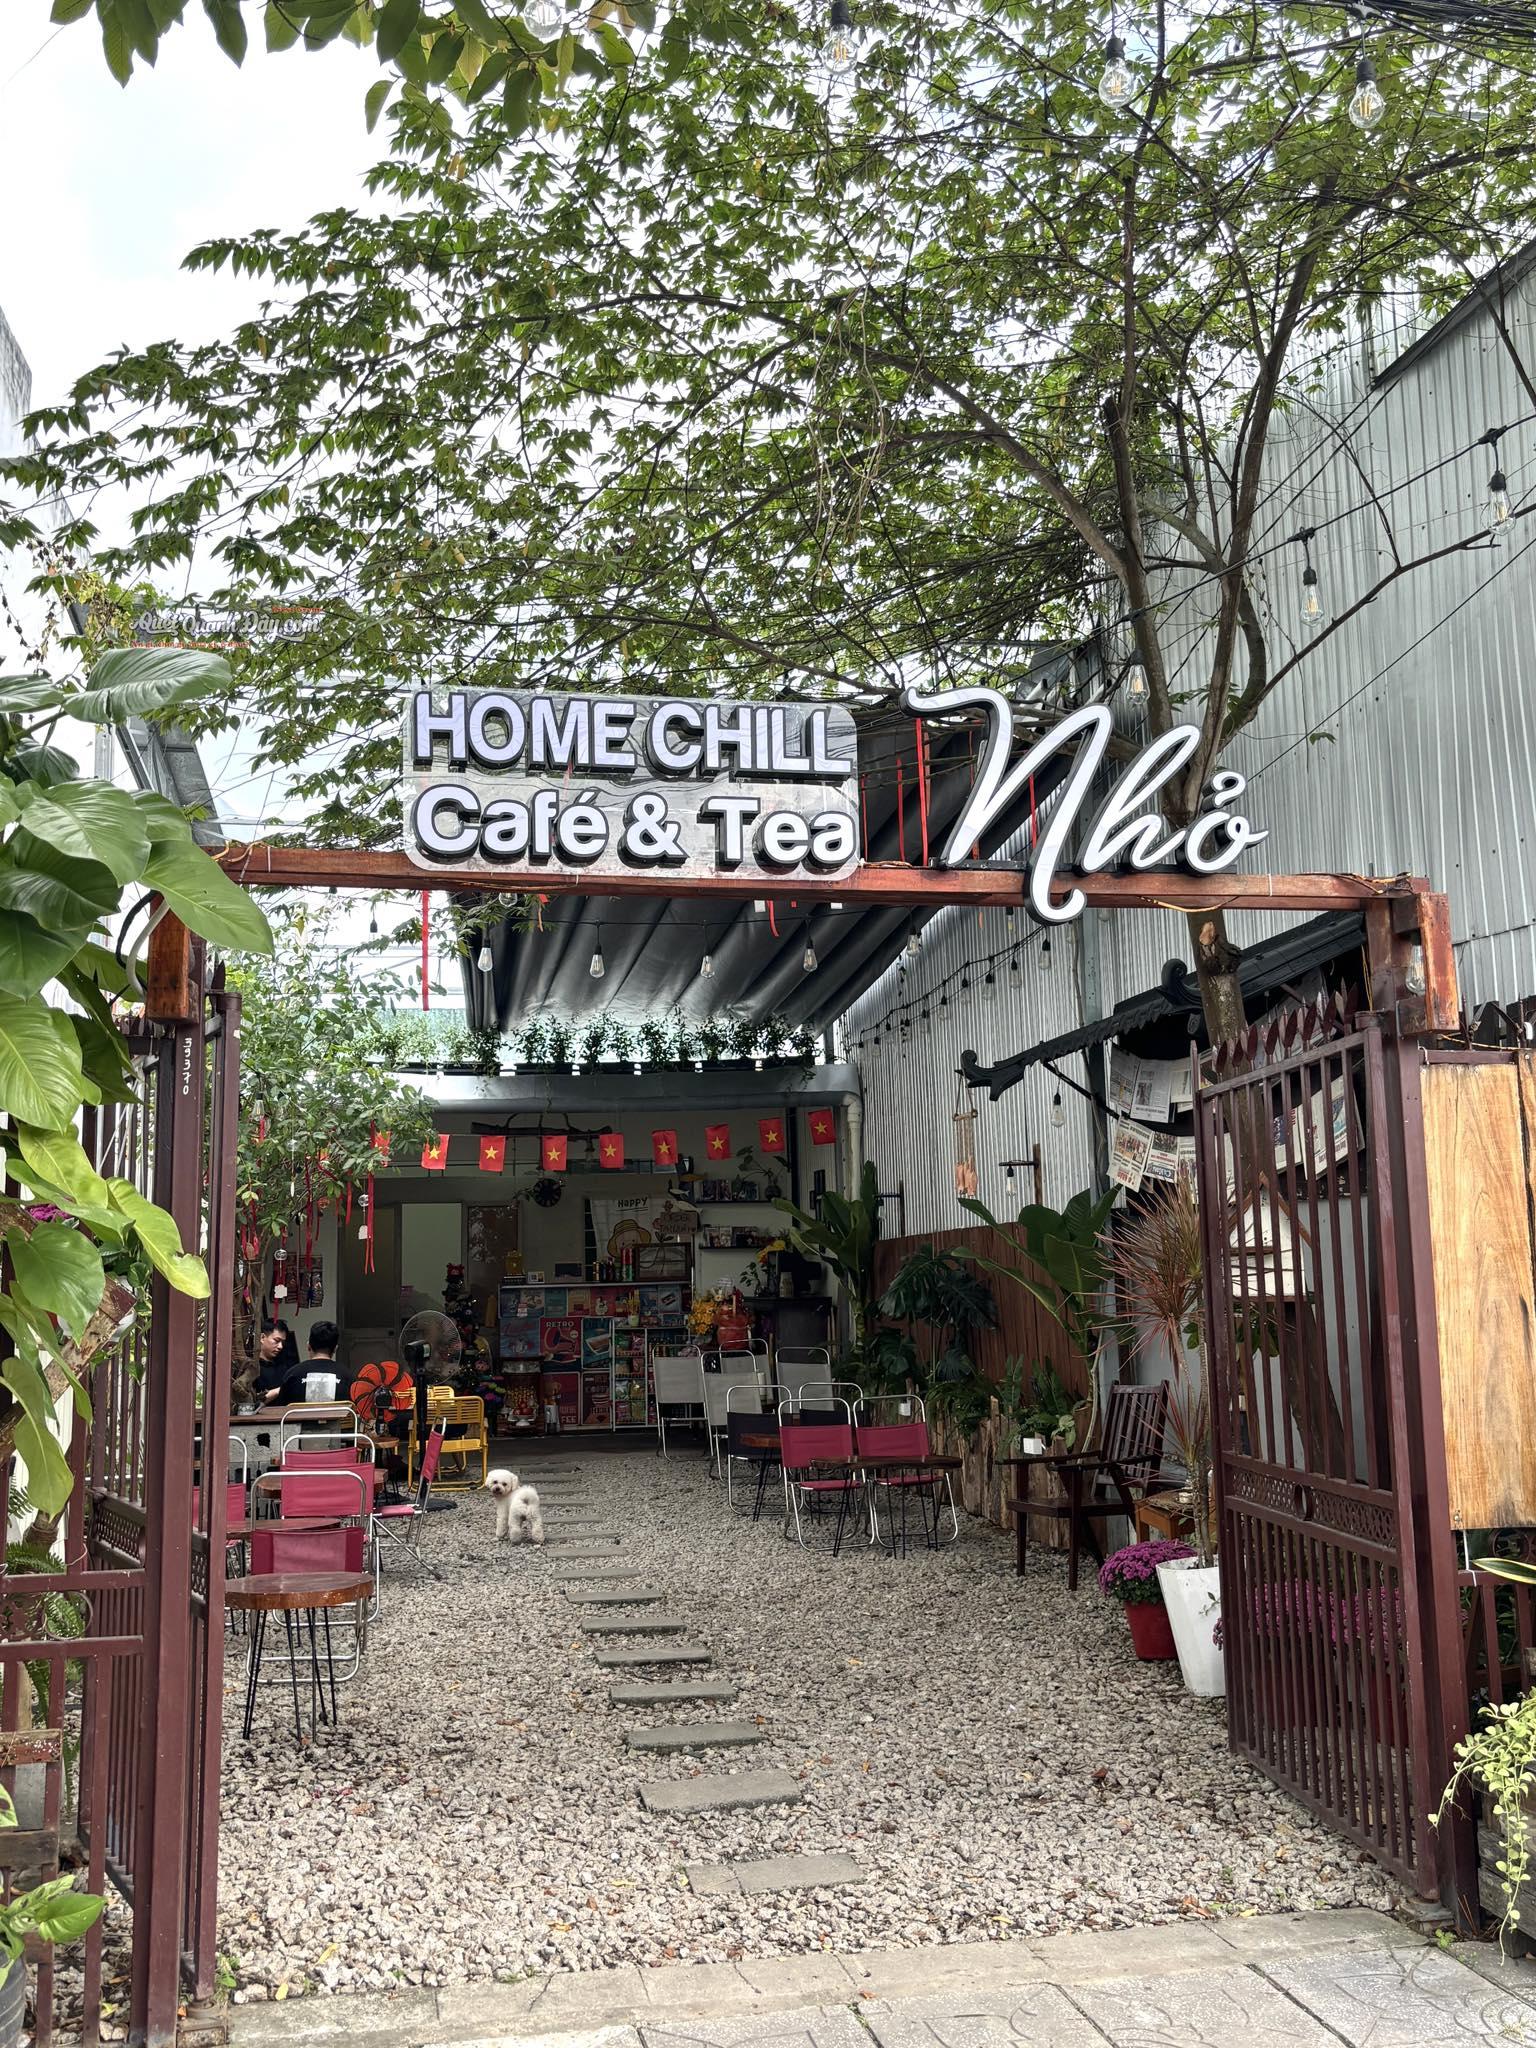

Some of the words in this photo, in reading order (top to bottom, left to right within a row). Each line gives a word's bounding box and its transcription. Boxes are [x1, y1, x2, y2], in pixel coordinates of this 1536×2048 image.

[413, 691, 637, 773] HOME
[645, 700, 852, 779] CHILL
[413, 784, 609, 864] Café
[619, 792, 689, 867] &
[699, 797, 857, 871] Tea
[903, 686, 1269, 925] Nhỏ
[546, 1320, 575, 1328] RETRO
